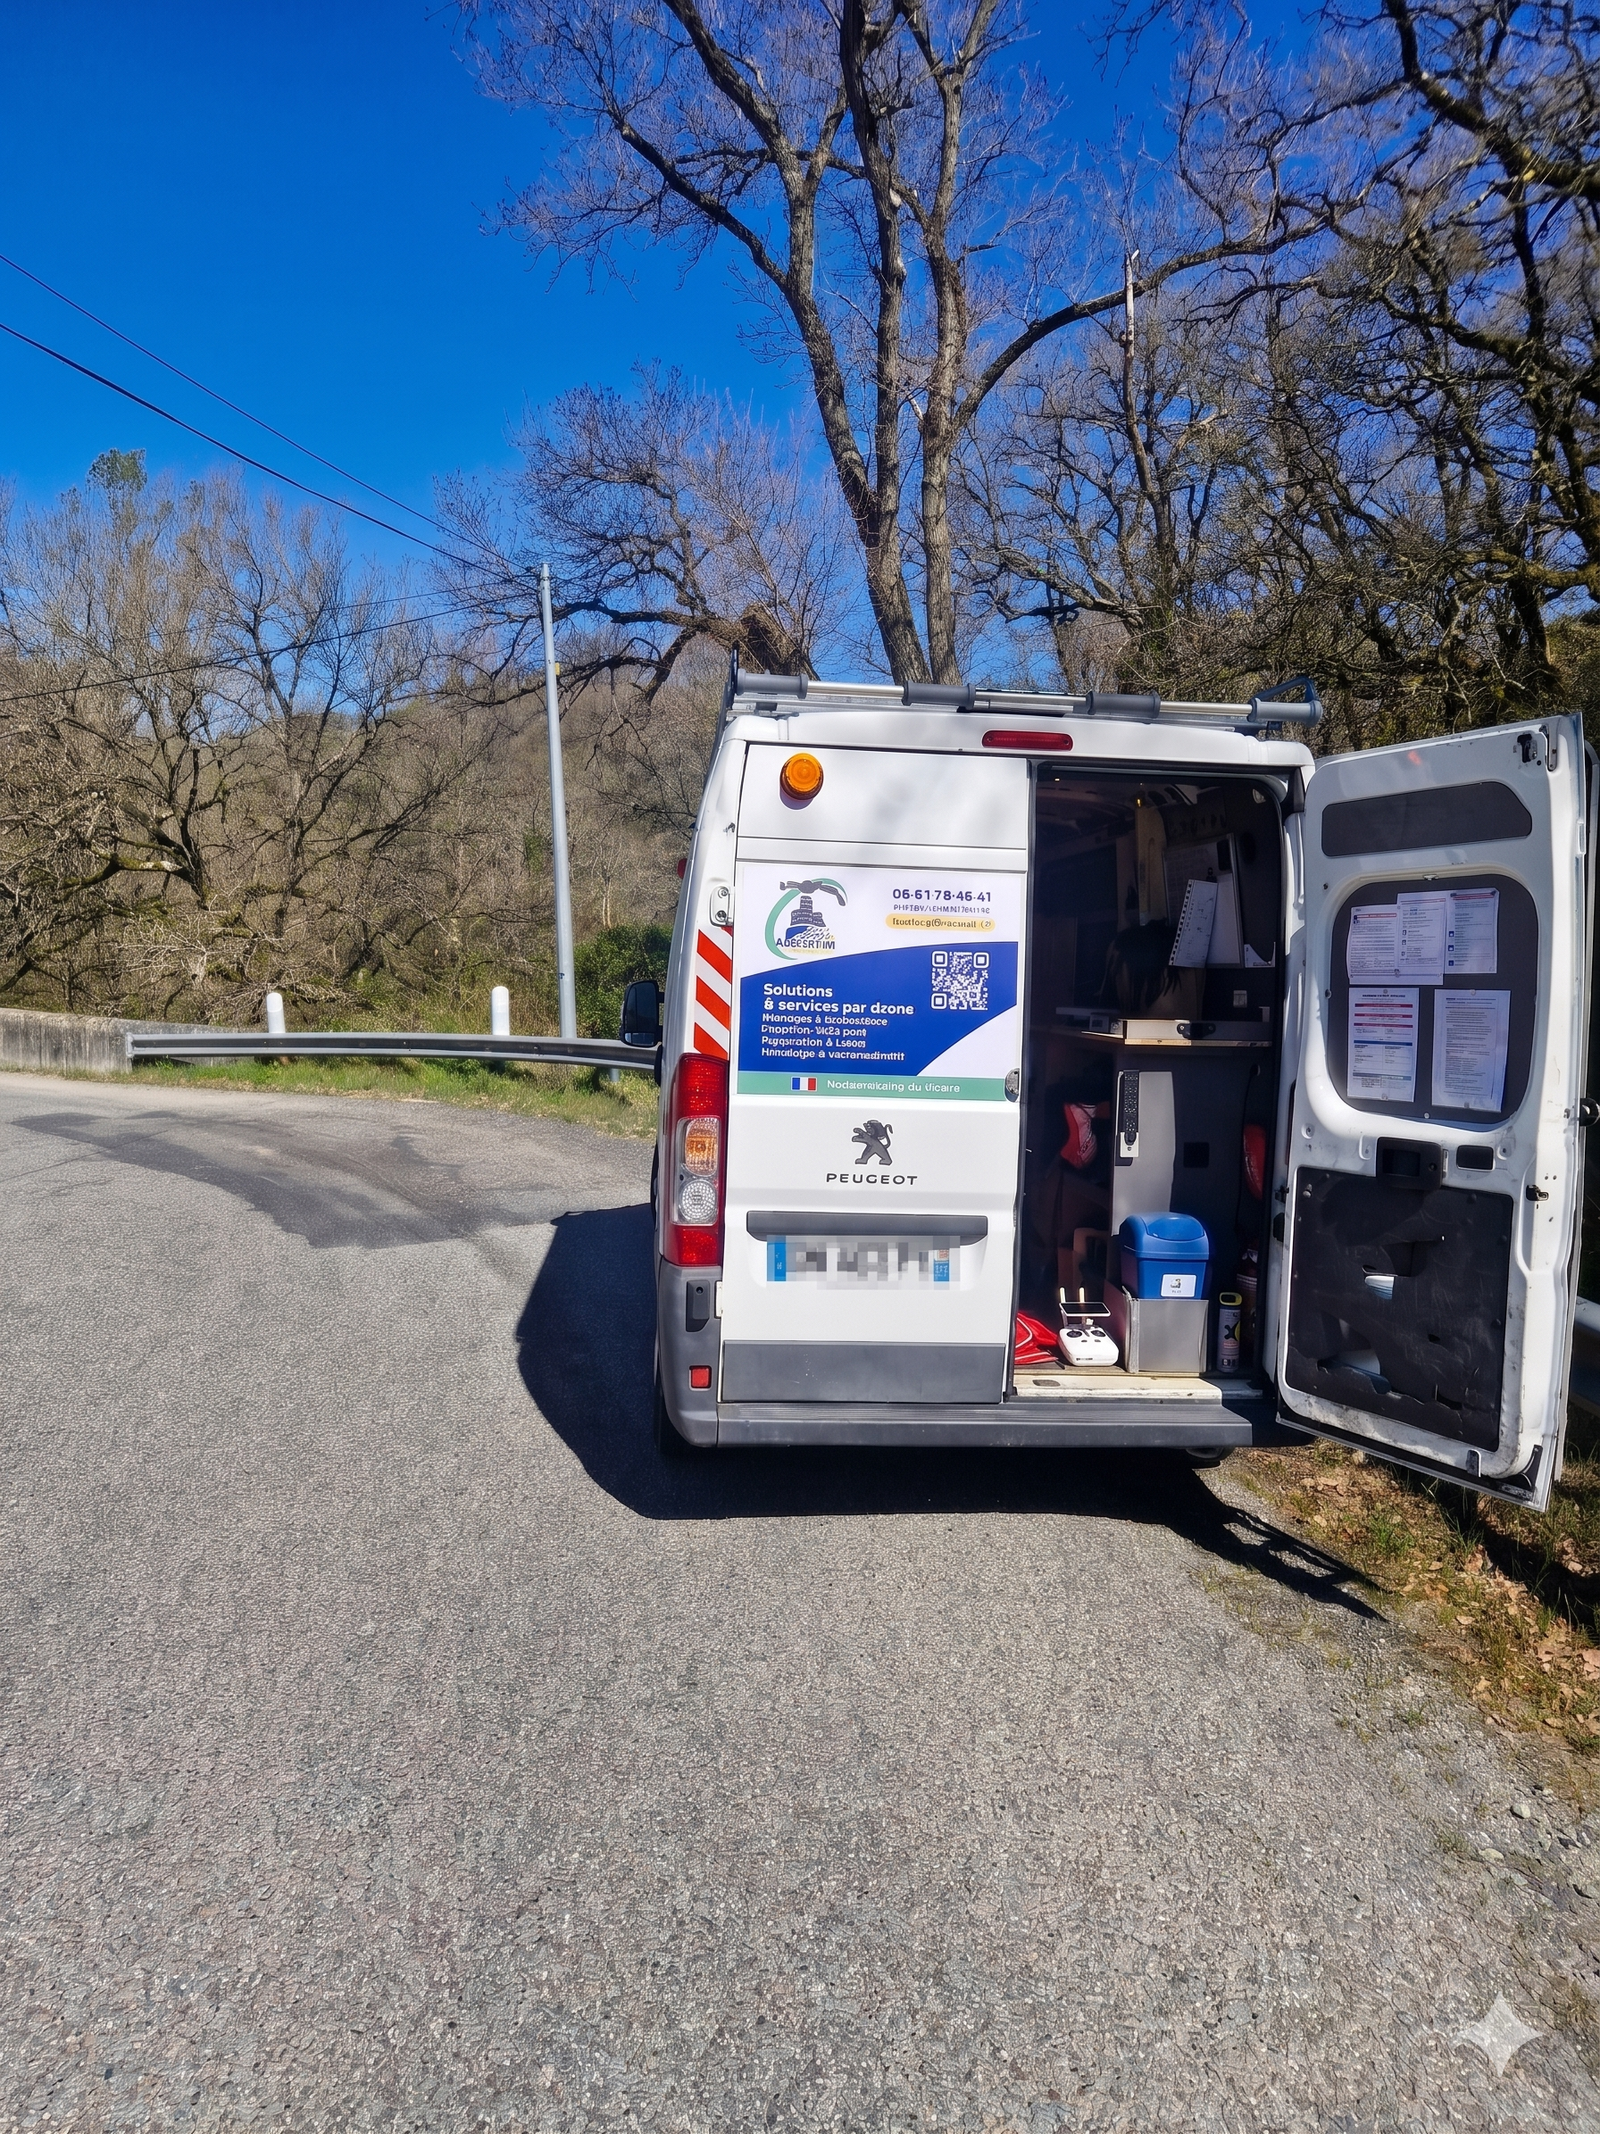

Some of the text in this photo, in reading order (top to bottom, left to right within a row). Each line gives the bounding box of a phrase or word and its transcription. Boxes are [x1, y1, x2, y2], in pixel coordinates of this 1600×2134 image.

[763, 983, 833, 997] Solutions
[778, 999, 839, 1012] services
[842, 1002, 867, 1015] par
[908, 1082, 921, 1092] du
[826, 1173, 918, 1186] PEUGEOT
